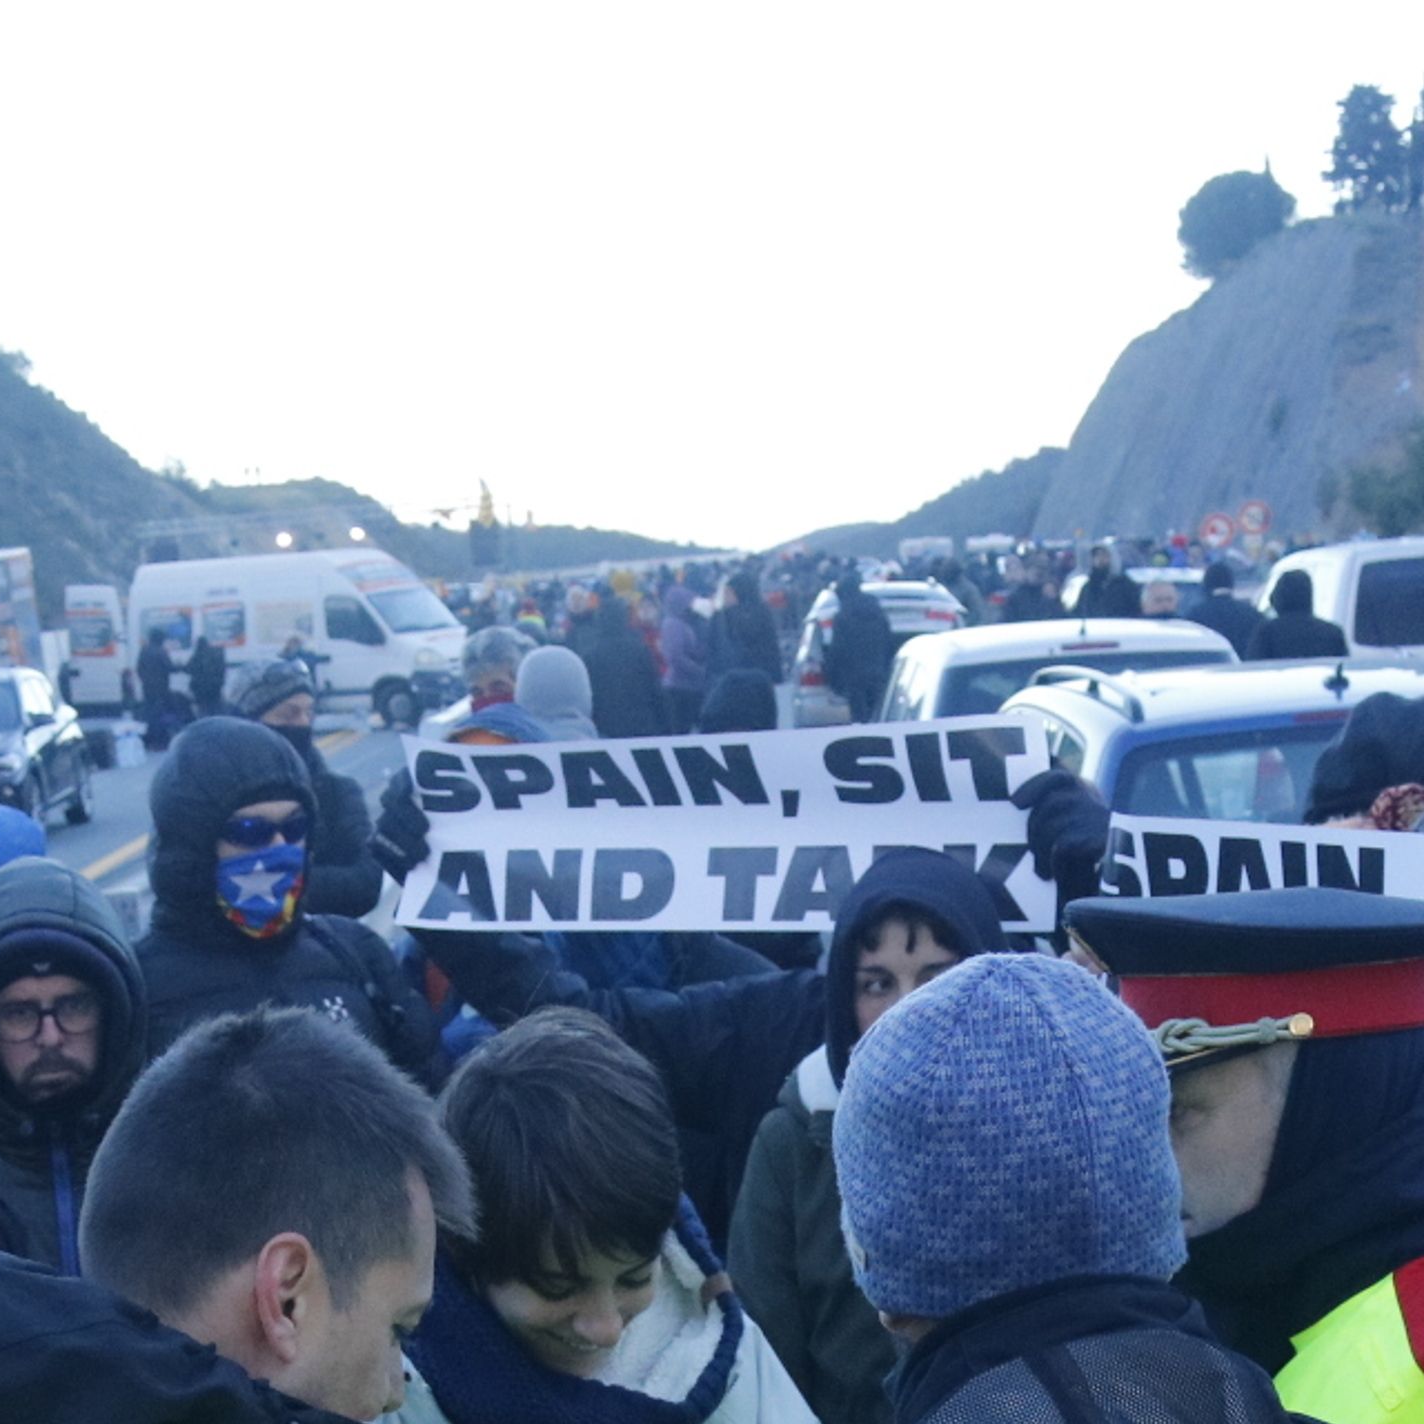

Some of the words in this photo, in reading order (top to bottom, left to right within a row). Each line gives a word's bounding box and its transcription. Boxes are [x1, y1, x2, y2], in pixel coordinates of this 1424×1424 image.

[414, 743, 799, 817] SPAIN,
[822, 727, 1027, 803] SIT
[418, 848, 677, 922] AND
[707, 843, 1029, 922] TAK
